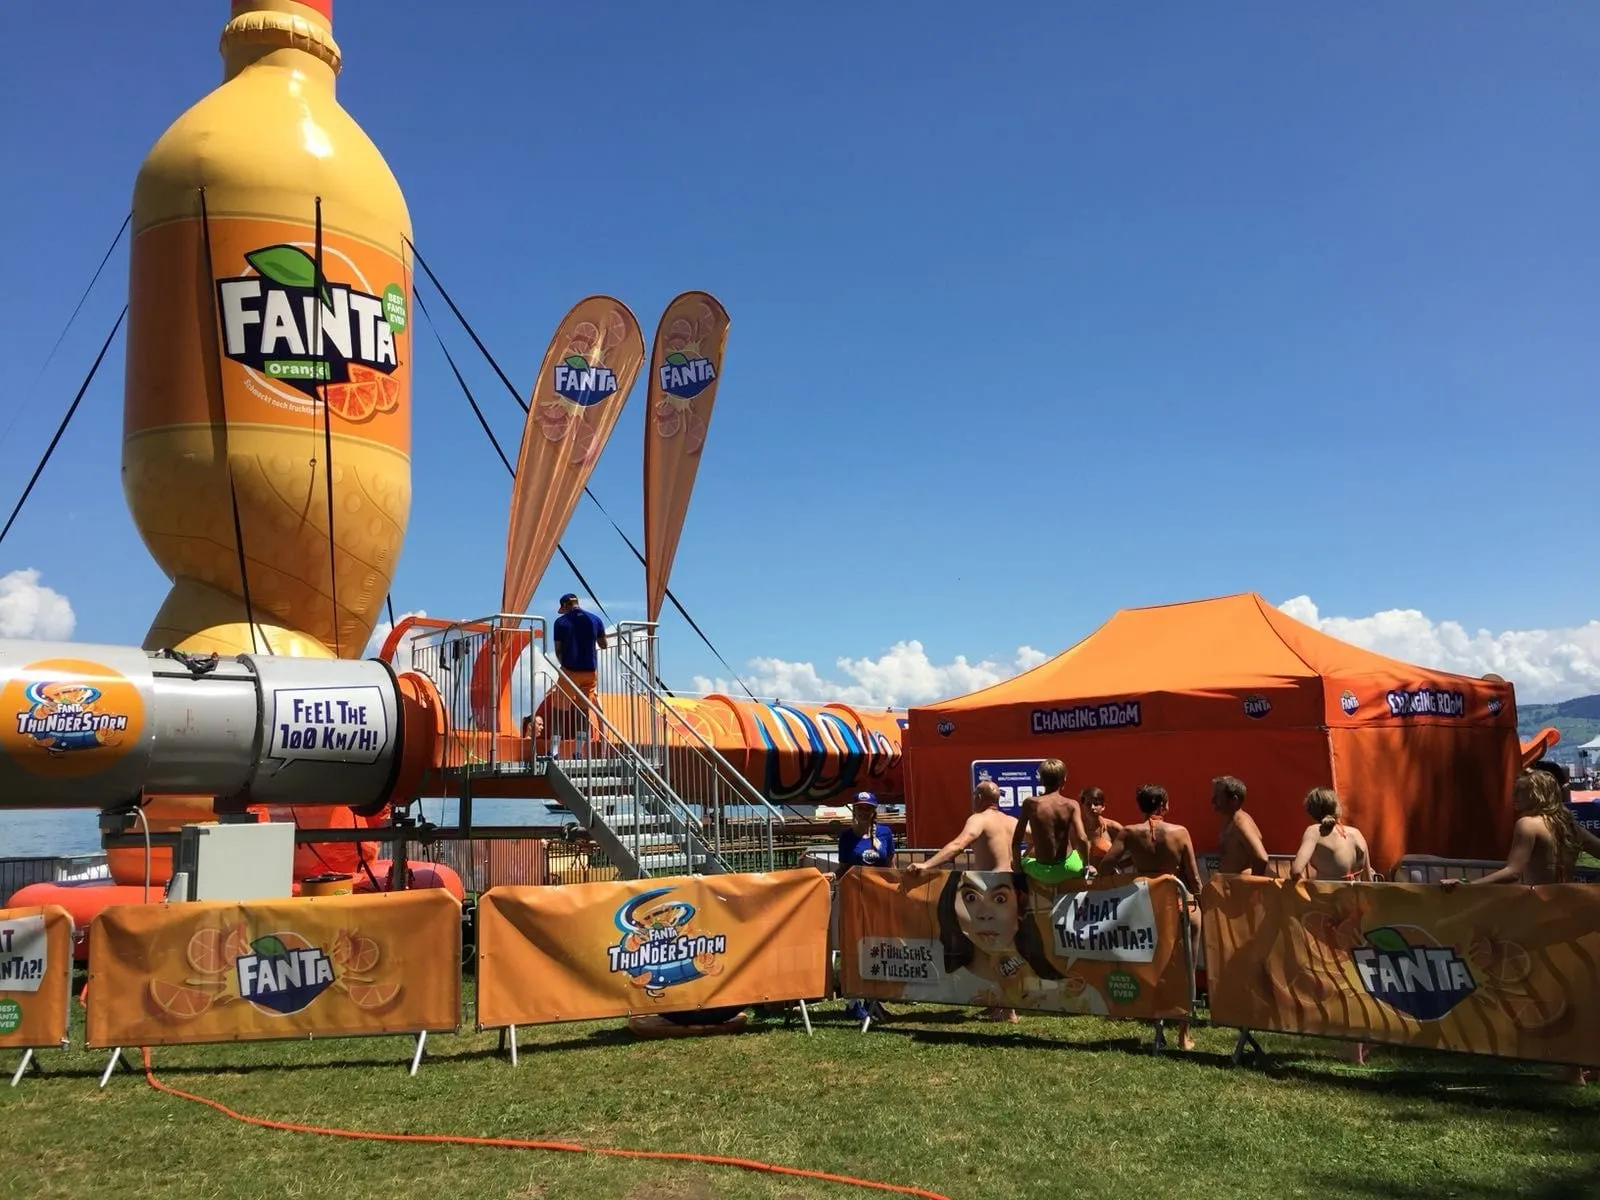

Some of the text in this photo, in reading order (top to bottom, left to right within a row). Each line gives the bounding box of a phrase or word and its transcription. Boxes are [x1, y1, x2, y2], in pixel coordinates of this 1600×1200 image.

[221, 280, 396, 365] FANTA
[555, 367, 617, 391] FANTA
[660, 359, 716, 389] FANTA
[58, 703, 84, 715] FANTA
[293, 699, 367, 725] FEEL THE
[1244, 698, 1272, 714] FANTA
[1387, 691, 1463, 714] CHANGING ROOM
[17, 713, 127, 733] THUNDERSTORM
[1033, 705, 1139, 731] CHANGING ROOM
[280, 724, 378, 751] 100 KM/H!
[1073, 897, 1120, 921] WHAT
[648, 927, 678, 941] FANTA
[1055, 924, 1154, 950] THE FANTA?!
[609, 936, 725, 971] THUNDERSTORM
[238, 950, 334, 996] FANTA
[1354, 948, 1476, 993] FANTA
[1113, 990, 1135, 999] EVER
